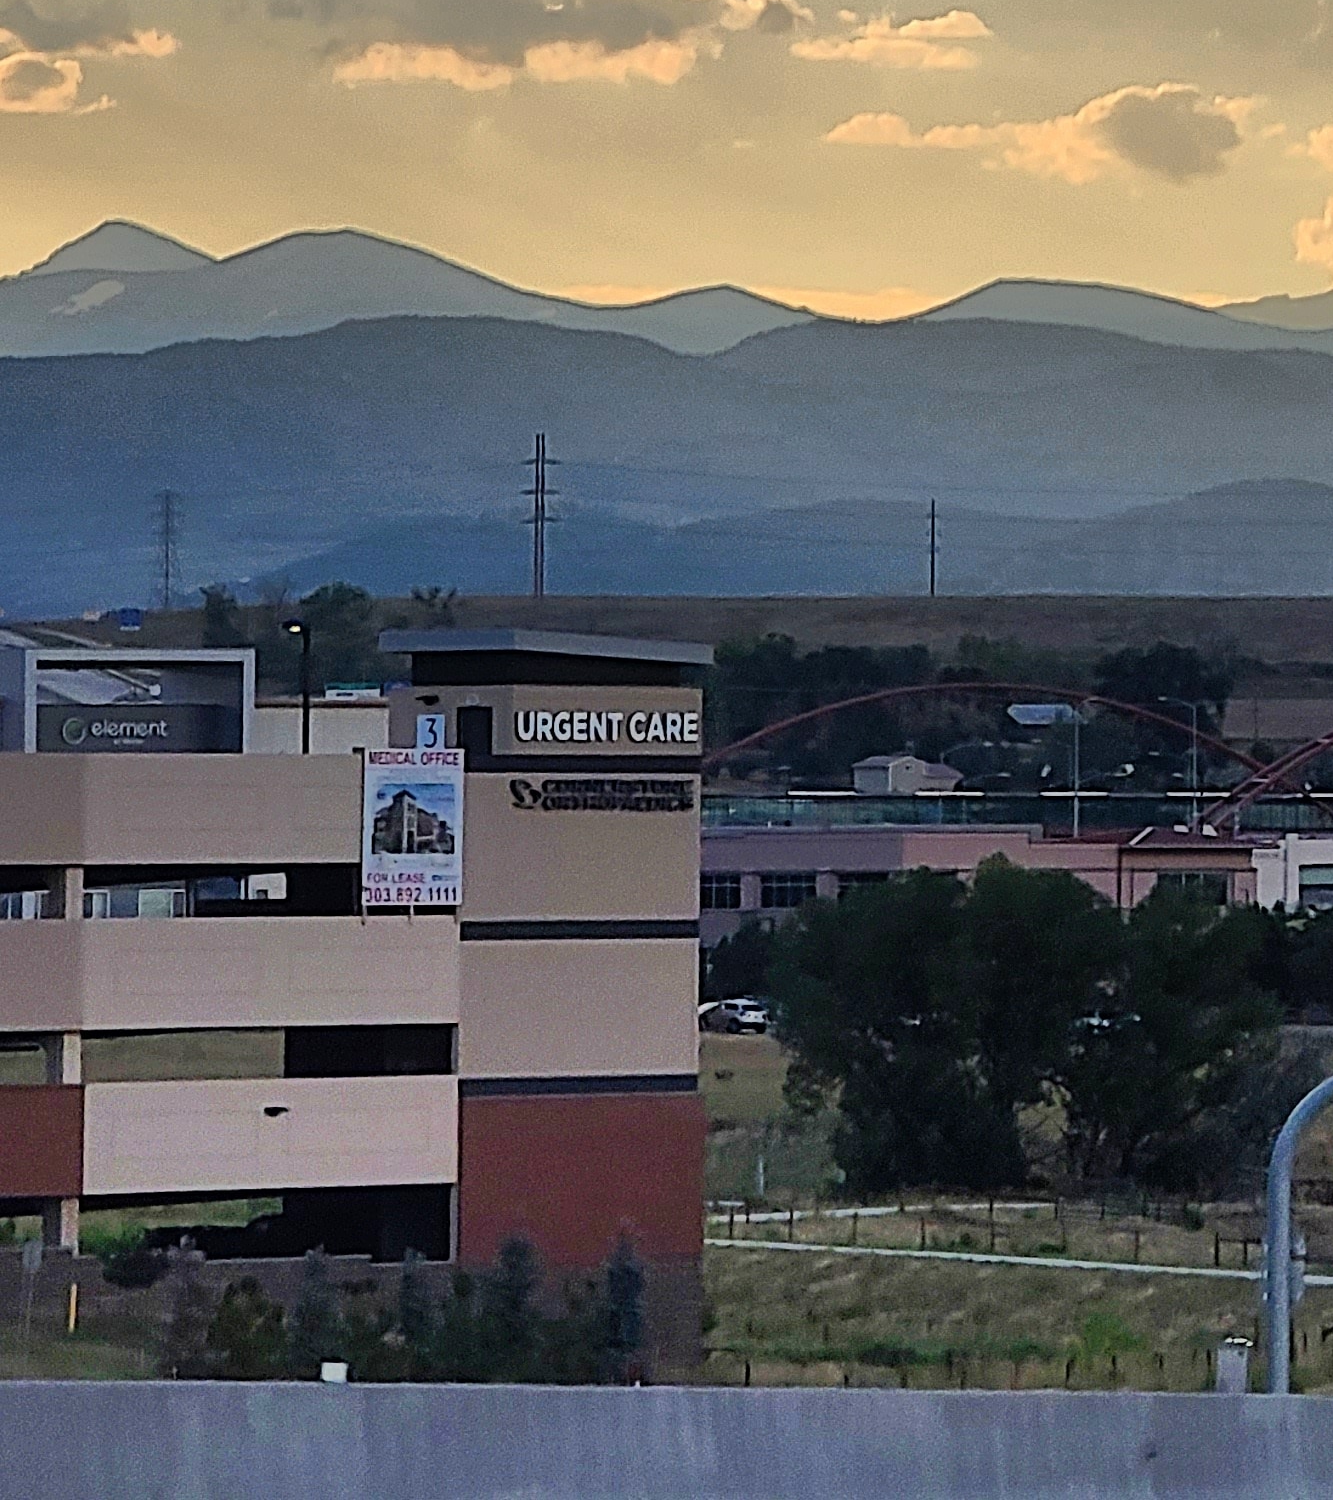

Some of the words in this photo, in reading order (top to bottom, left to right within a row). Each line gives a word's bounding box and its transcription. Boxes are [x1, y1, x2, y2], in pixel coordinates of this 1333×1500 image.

[90, 718, 168, 737] element
[423, 717, 438, 749] 3
[515, 710, 624, 742] URGENT
[628, 711, 699, 742] CARE
[369, 751, 417, 766] MEDICAL
[420, 751, 460, 766] OFFICE
[367, 872, 389, 884] FOR
[392, 872, 426, 884] LEASE
